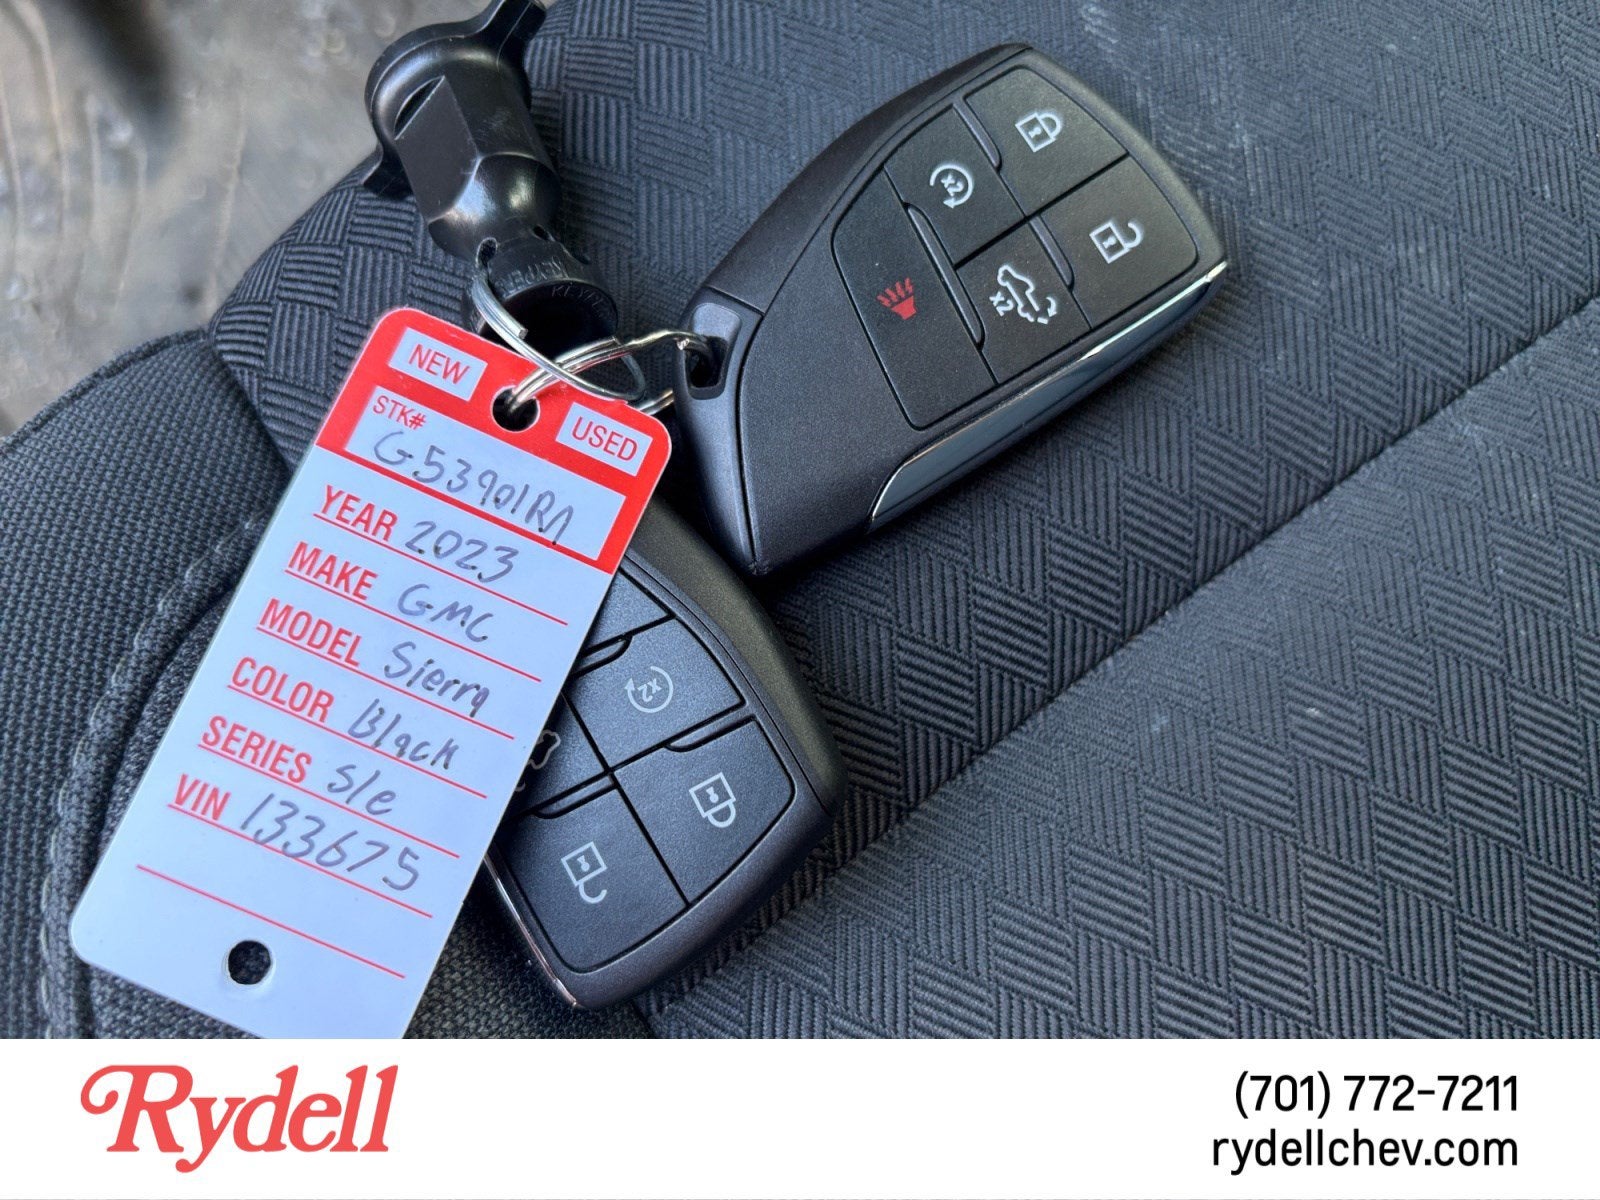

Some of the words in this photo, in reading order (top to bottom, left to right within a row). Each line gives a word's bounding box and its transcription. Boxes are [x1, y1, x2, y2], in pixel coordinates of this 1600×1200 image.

[407, 343, 470, 385] NEW
[372, 395, 427, 430] STK#
[571, 416, 638, 462] USED
[321, 484, 398, 542] YEAR
[288, 541, 378, 600] MAKE
[404, 520, 519, 584] 2023
[258, 598, 363, 668] MODEL
[396, 583, 493, 643] GMC
[231, 656, 335, 723] COLOR
[201, 715, 312, 784] SERIES
[347, 698, 460, 770] Black
[172, 773, 231, 822] VIN
[240, 793, 420, 892] 133675
